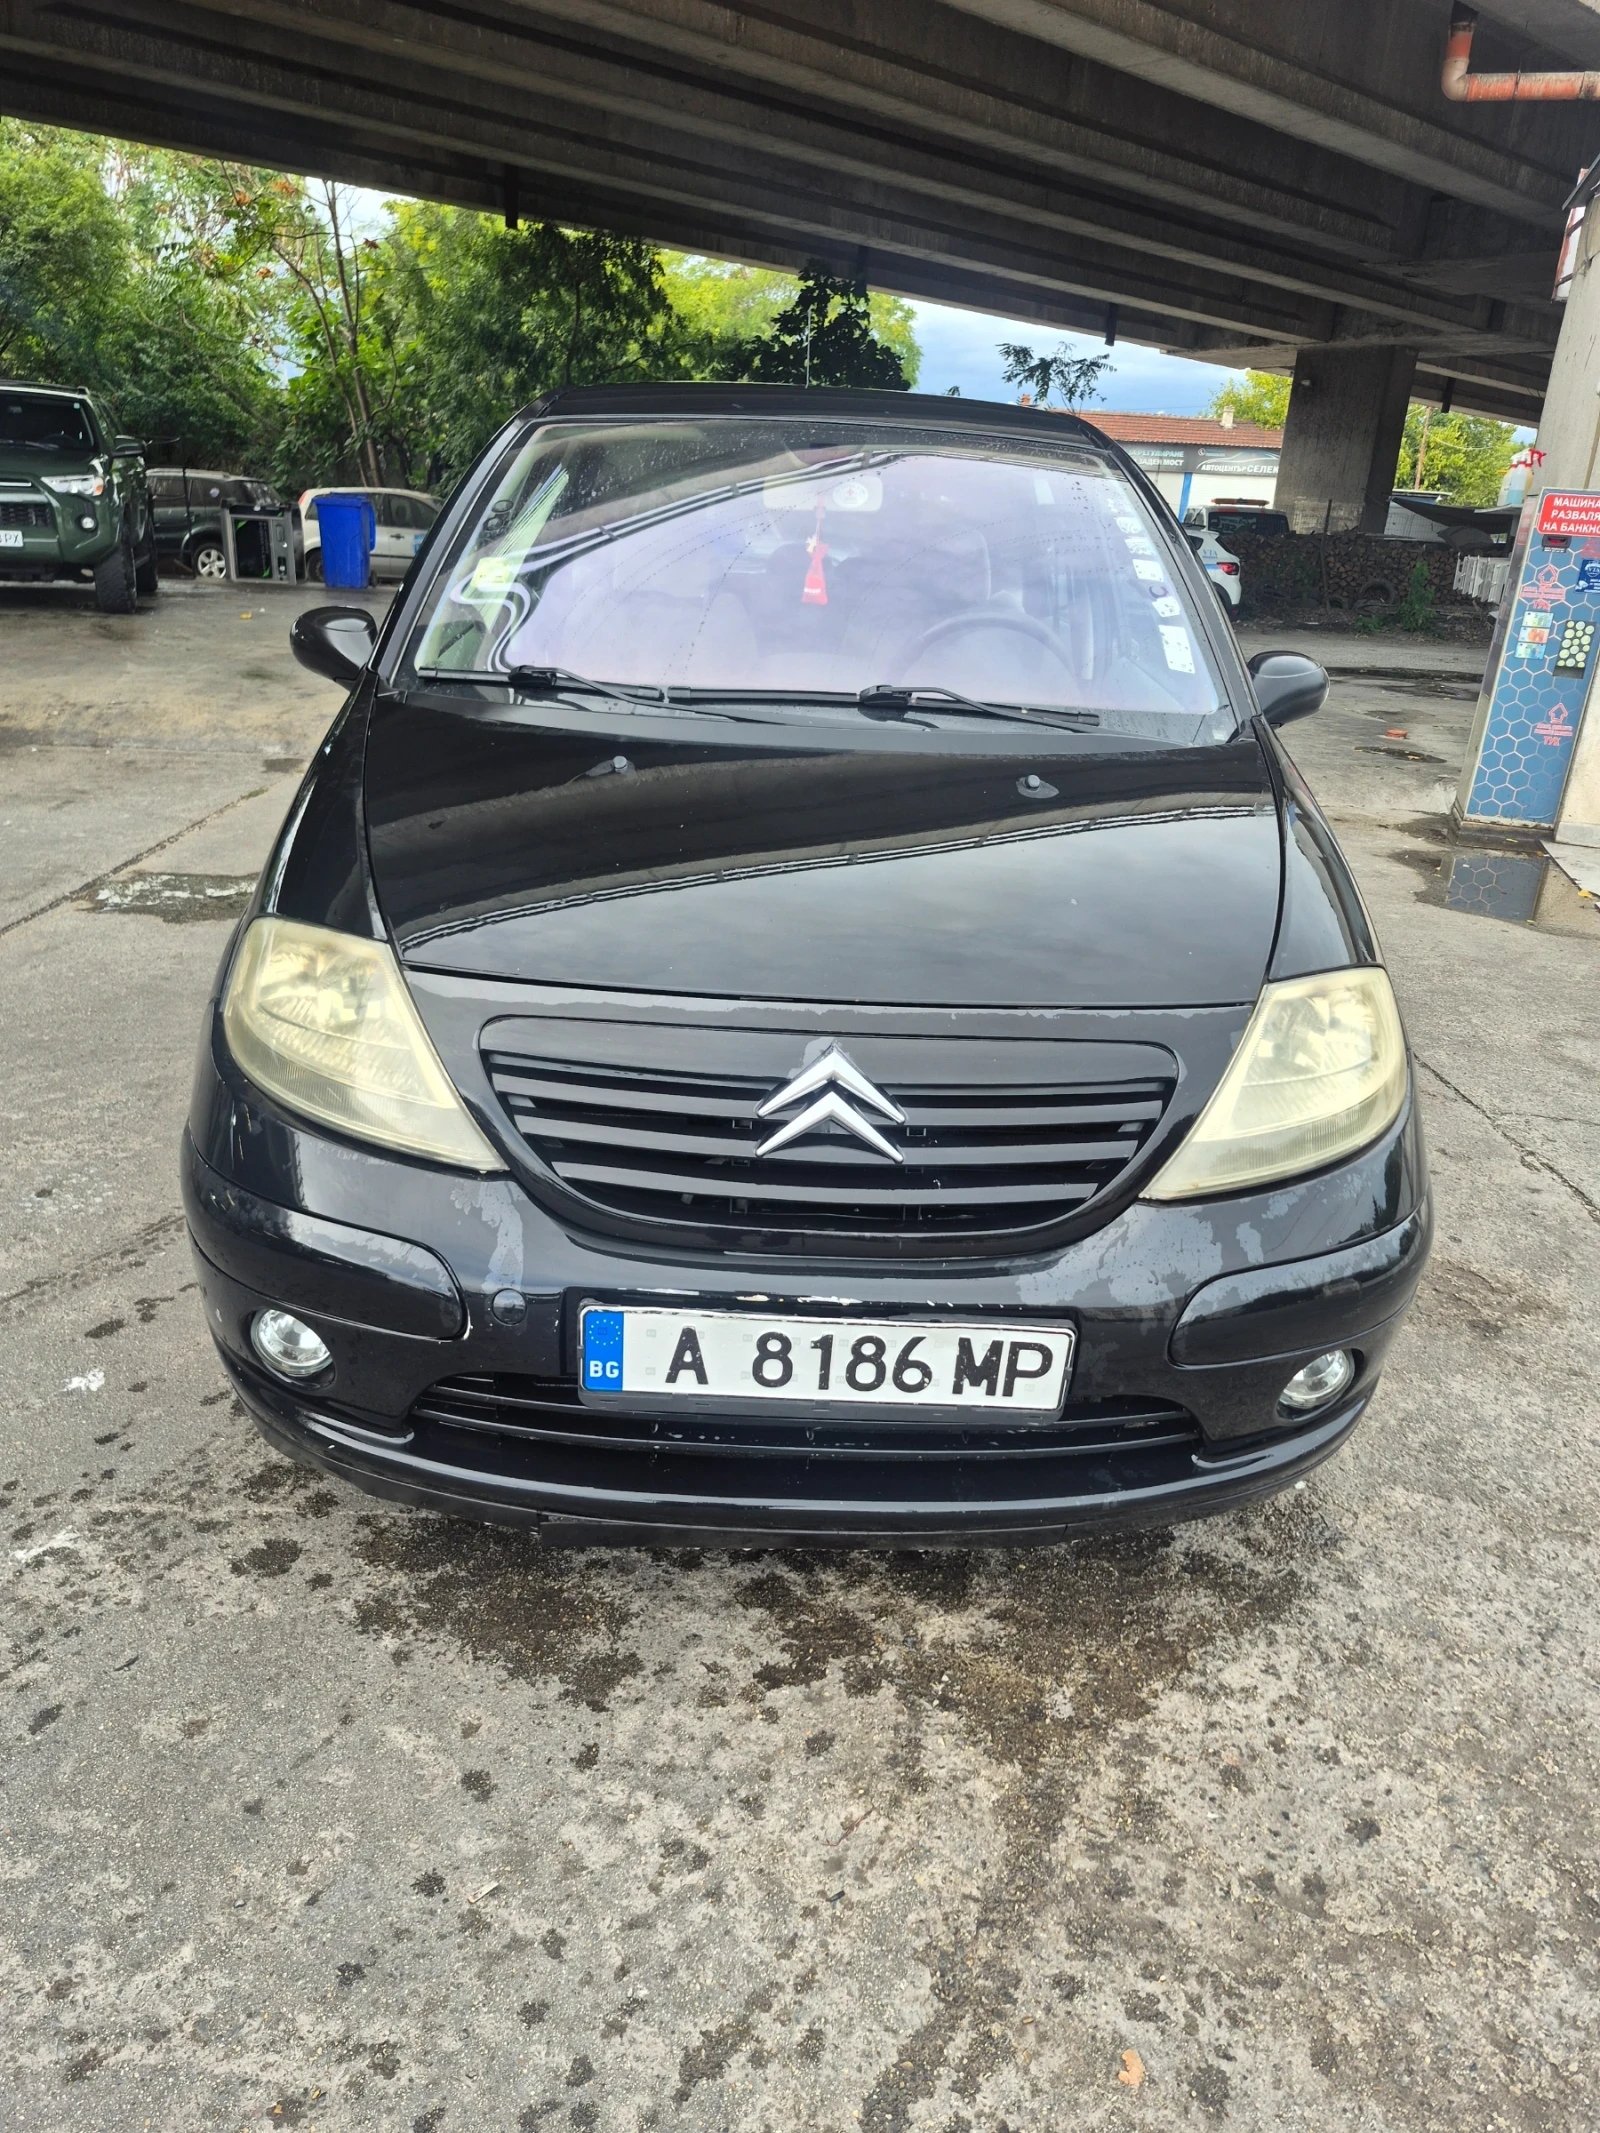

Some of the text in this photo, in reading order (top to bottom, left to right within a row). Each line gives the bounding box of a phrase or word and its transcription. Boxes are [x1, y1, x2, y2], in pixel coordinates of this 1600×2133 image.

[1553, 497, 1600, 508] МАШИНА
[1551, 509, 1600, 521] РАЗВАЛЯ
[1542, 521, 1557, 531] НА
[665, 1326, 1053, 1397] A 8186 MP
[589, 1360, 619, 1378] BG
